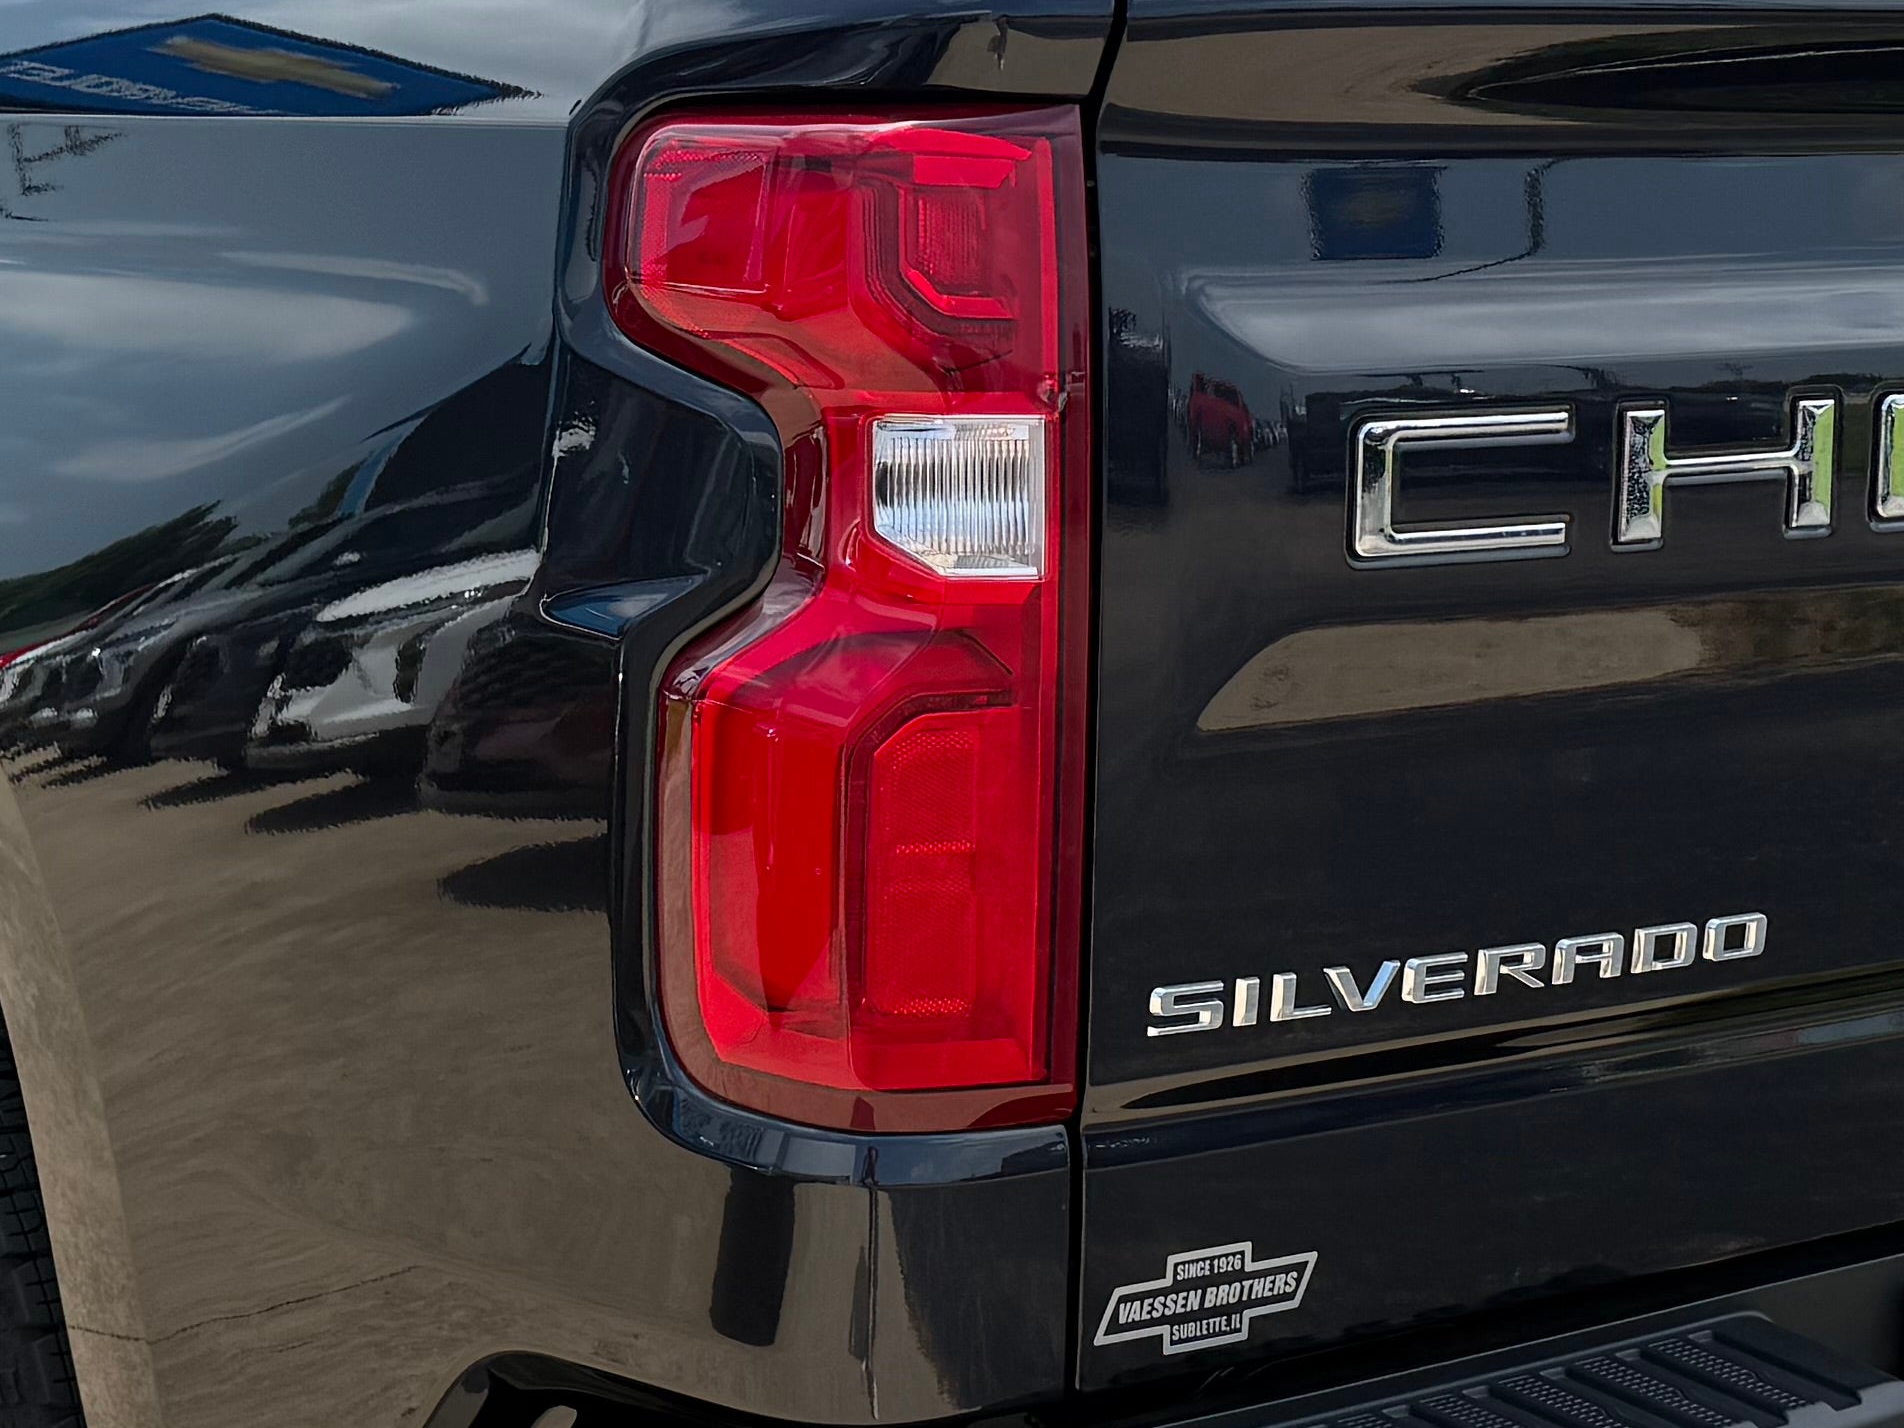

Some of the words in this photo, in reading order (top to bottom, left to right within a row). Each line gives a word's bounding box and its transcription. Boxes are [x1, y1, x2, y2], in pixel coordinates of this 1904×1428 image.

[1146, 911, 1769, 1037] SILVERADO
[1177, 1262, 1211, 1281] SINCE
[1213, 1255, 1242, 1274] 1926
[1118, 1288, 1200, 1324] VAESSEN
[1204, 1271, 1299, 1308] BROTHERS
